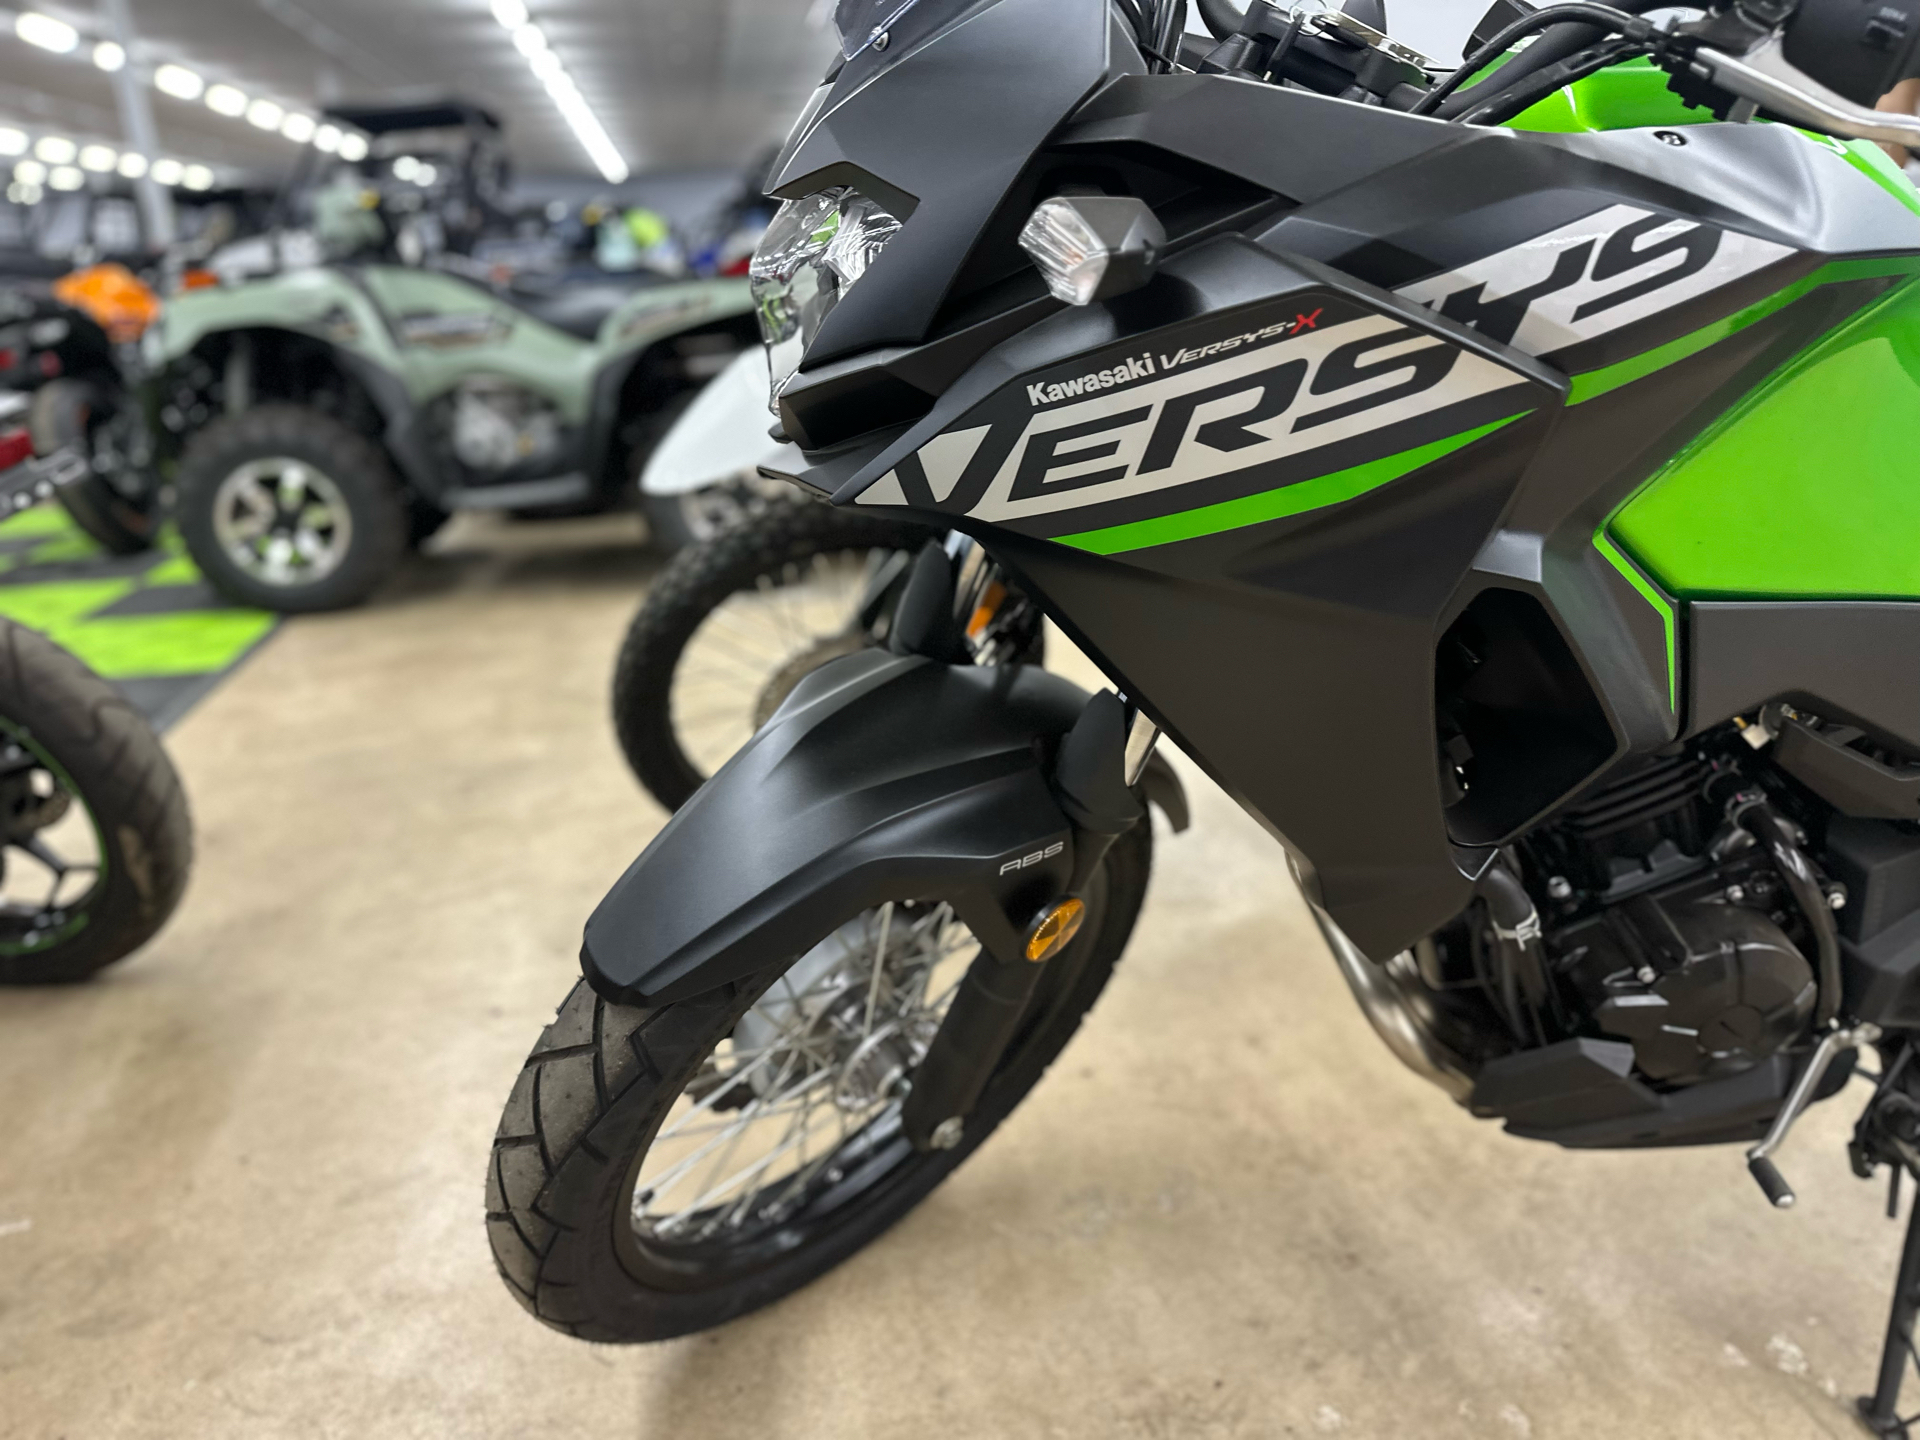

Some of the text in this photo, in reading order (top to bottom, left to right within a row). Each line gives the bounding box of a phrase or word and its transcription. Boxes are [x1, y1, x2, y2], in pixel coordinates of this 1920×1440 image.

[1026, 308, 1324, 406] Kawasaki VERSYS-X
[999, 841, 1064, 876] ABS
